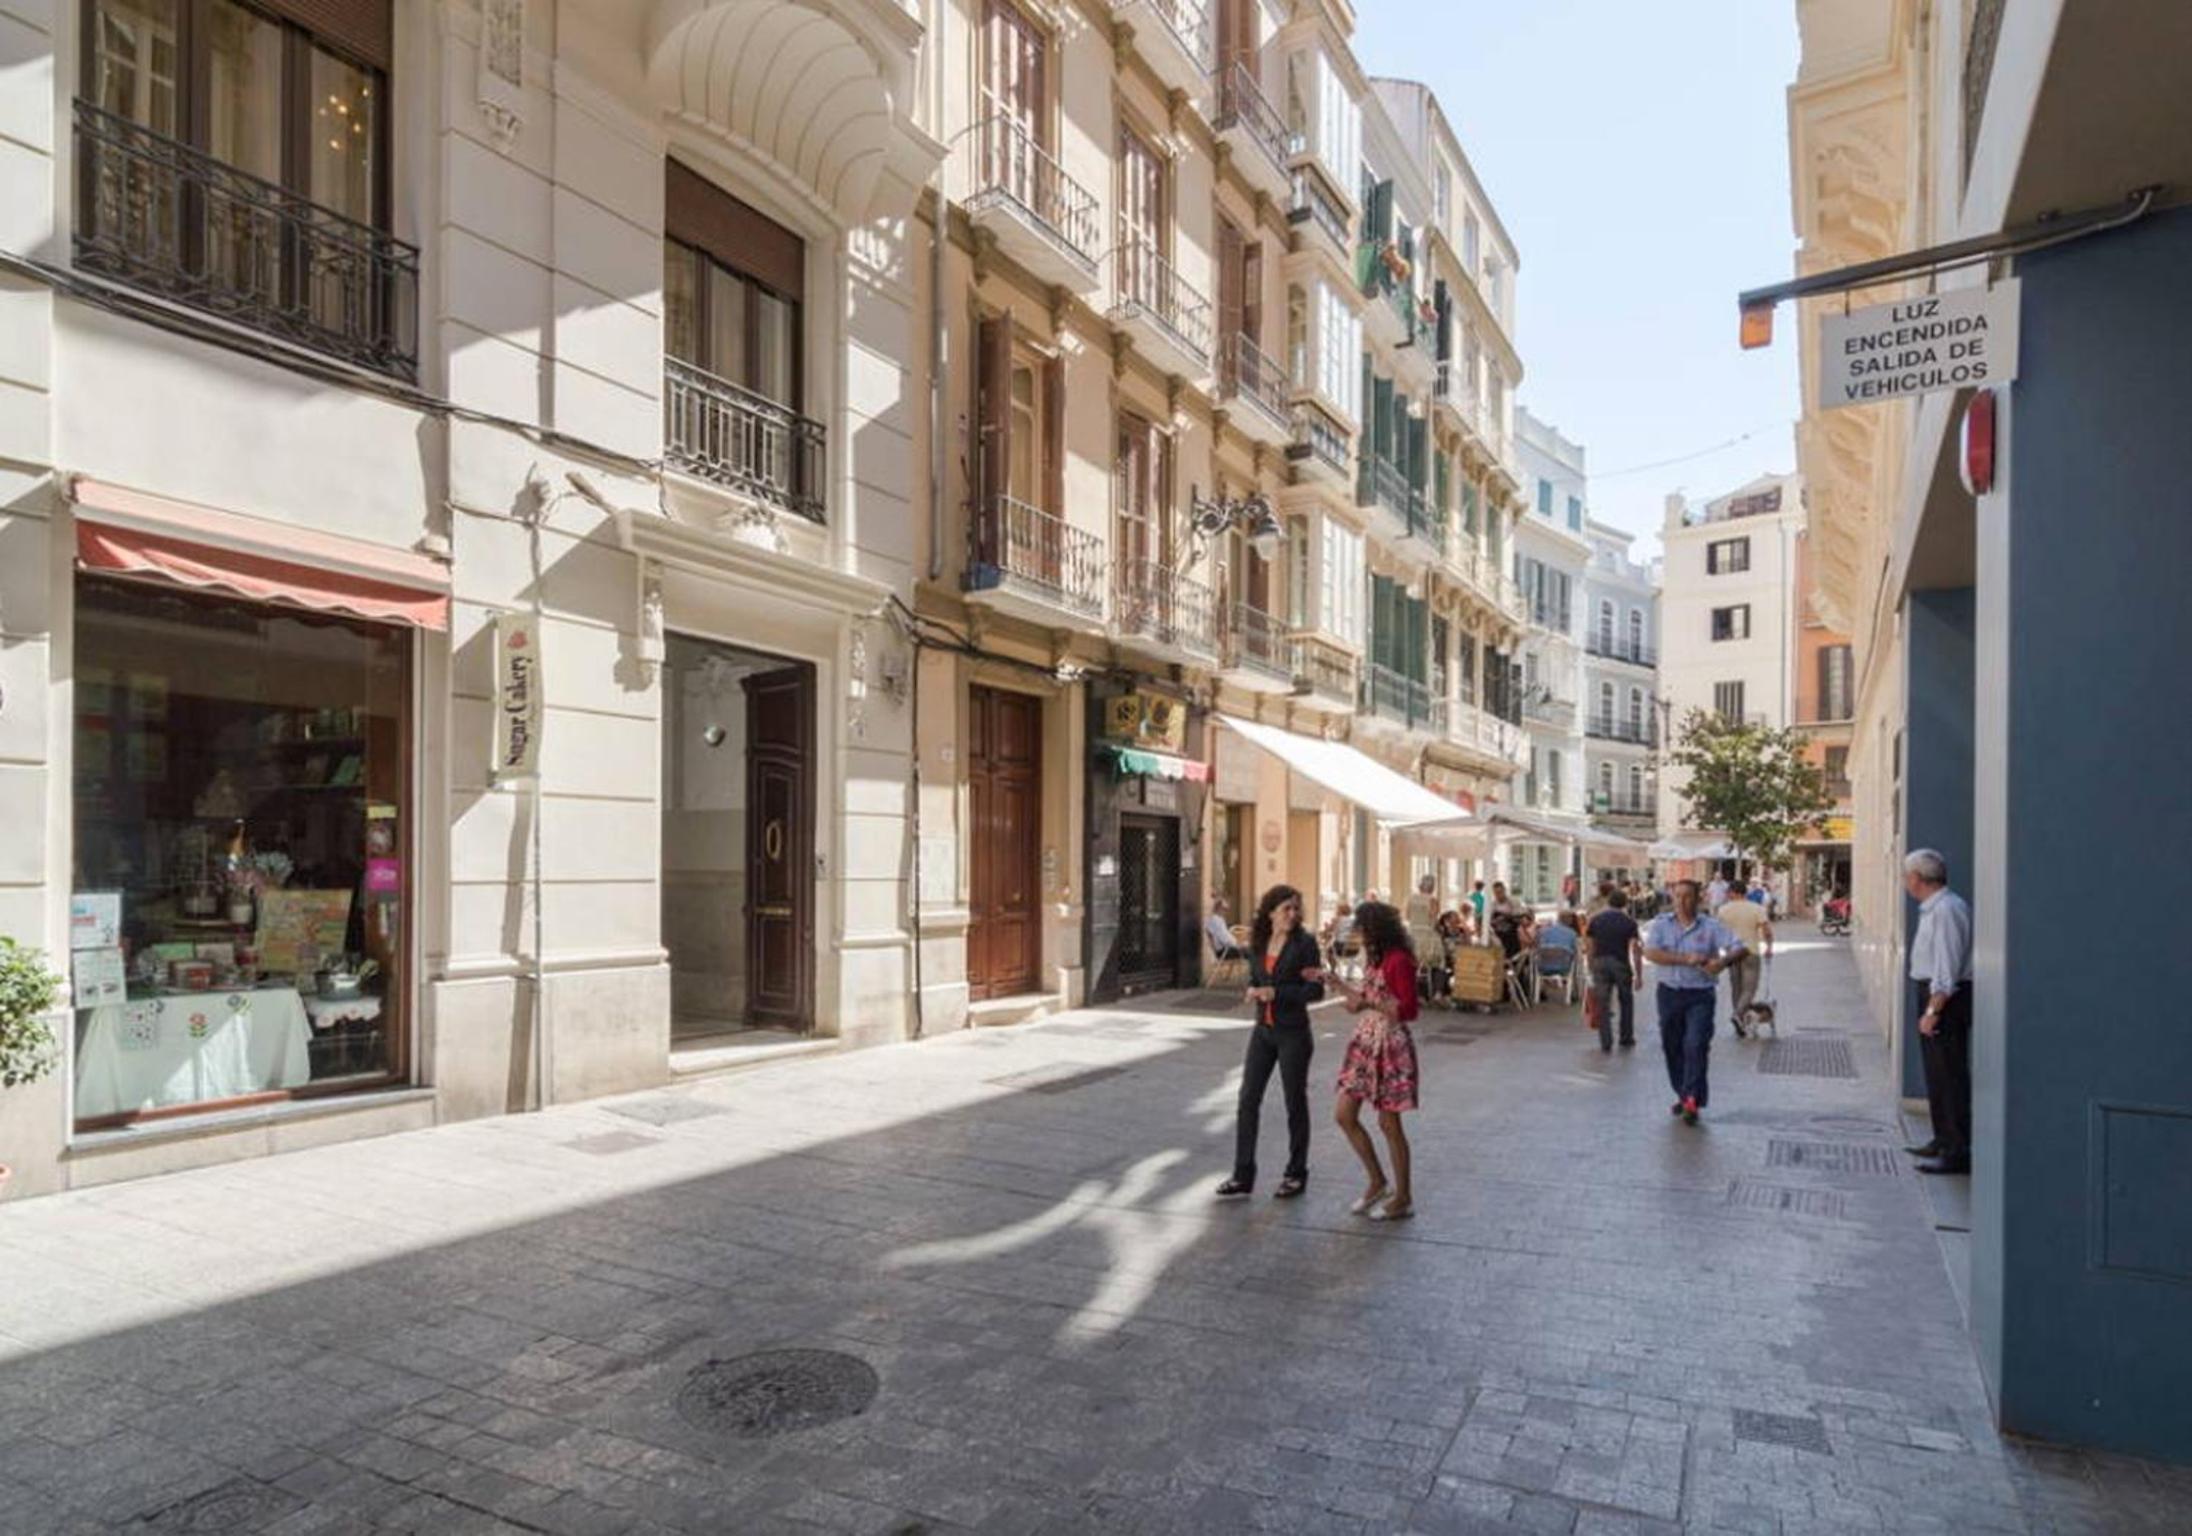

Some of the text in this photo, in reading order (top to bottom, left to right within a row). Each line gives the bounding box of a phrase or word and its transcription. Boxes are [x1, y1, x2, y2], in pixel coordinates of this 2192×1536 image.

[1892, 299, 1940, 323] LUZ
[1844, 315, 1988, 355] ENCENDIDA
[1850, 338, 1984, 377] SALIDA DE
[1845, 362, 1988, 400] VEHICULOS
